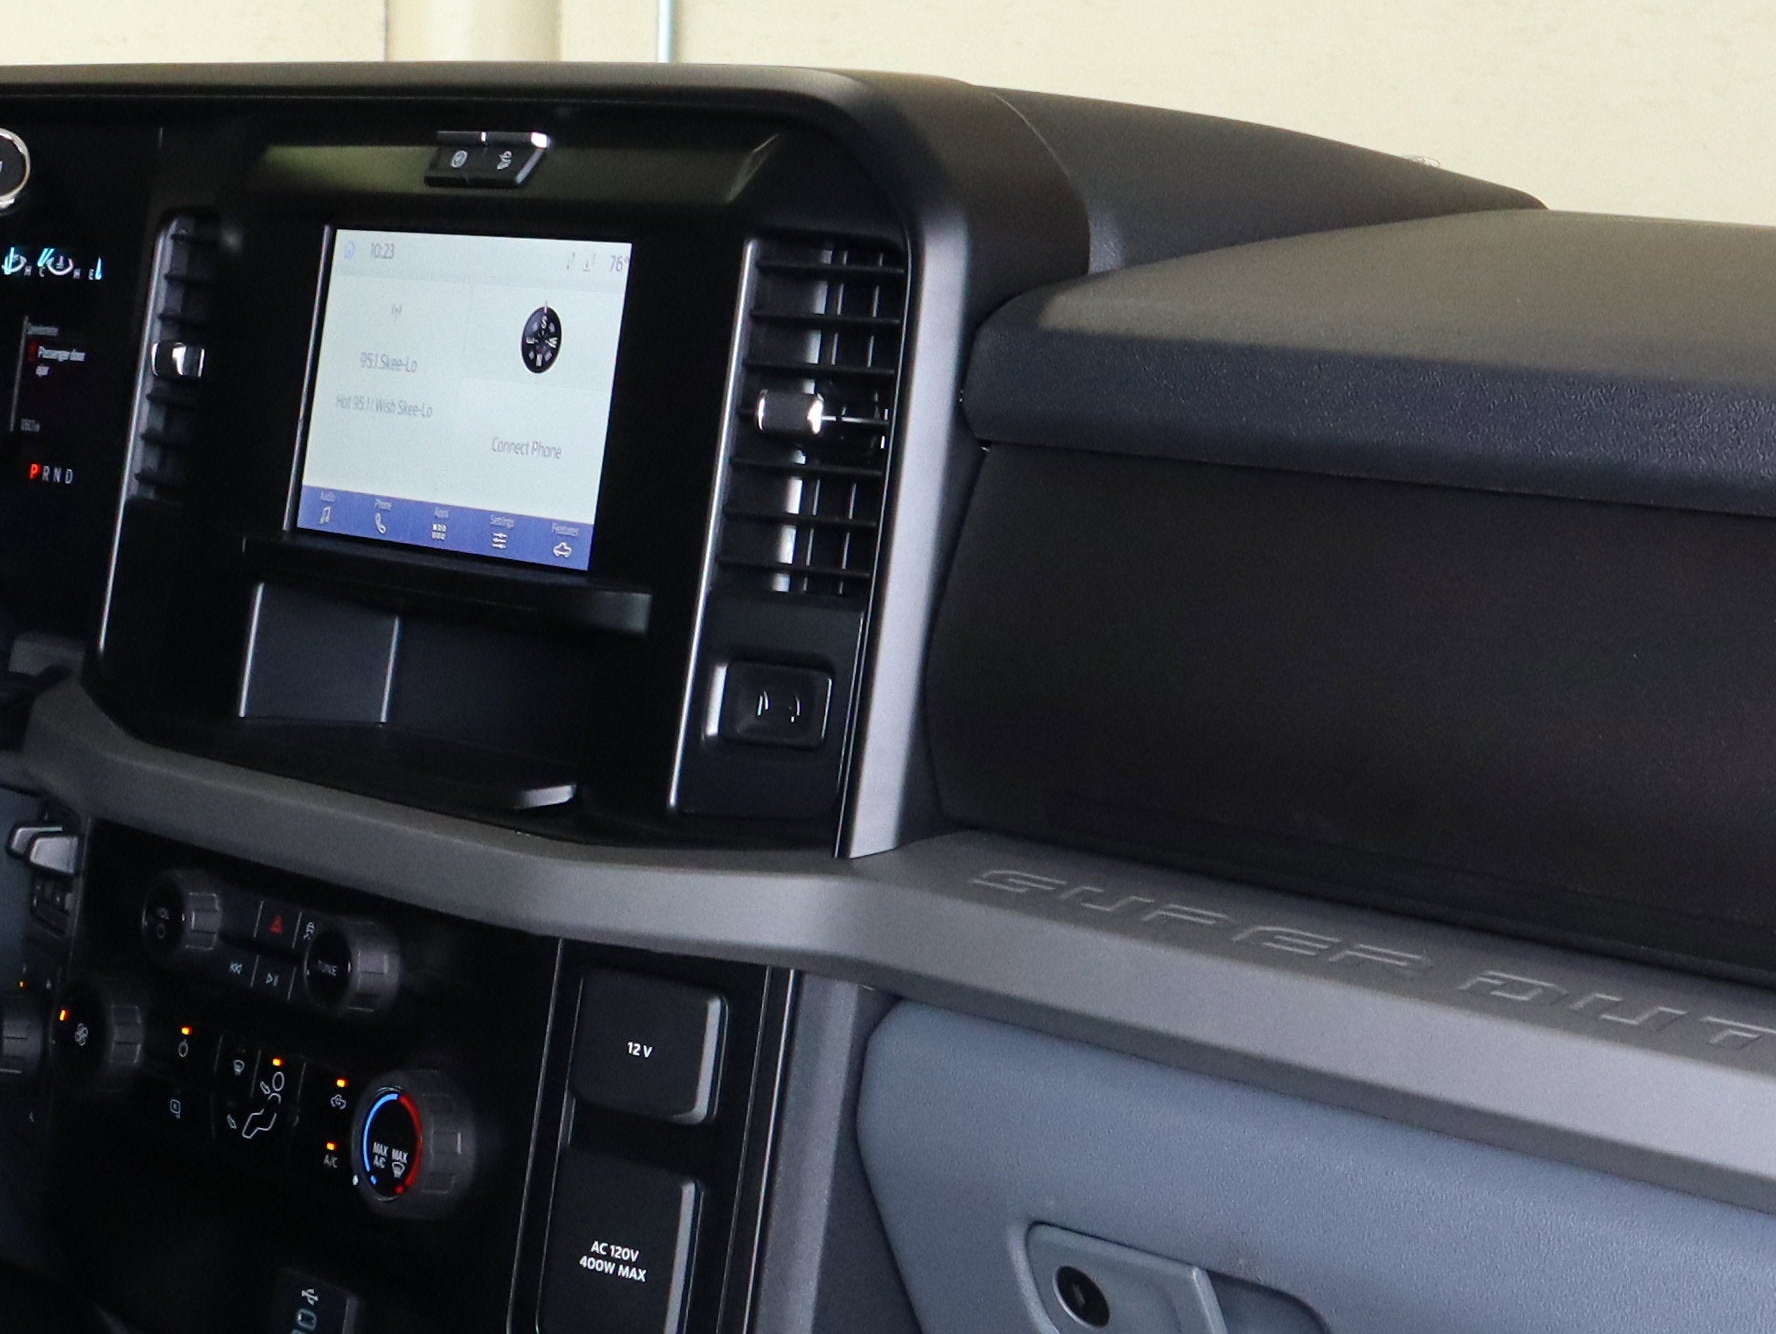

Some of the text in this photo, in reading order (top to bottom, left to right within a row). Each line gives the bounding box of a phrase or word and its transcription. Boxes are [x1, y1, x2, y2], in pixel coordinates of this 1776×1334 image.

[370, 242, 395, 259] 10:23
[541, 315, 549, 329] S
[491, 436, 562, 459] Connect Phone
[29, 463, 73, 484] P R N D
[967, 869, 1434, 977] SUPER
[372, 1141, 389, 1158] MAX
[391, 1148, 409, 1164] MAX
[590, 1240, 640, 1263] AC 120V
[579, 1255, 647, 1283] 400W MAX
